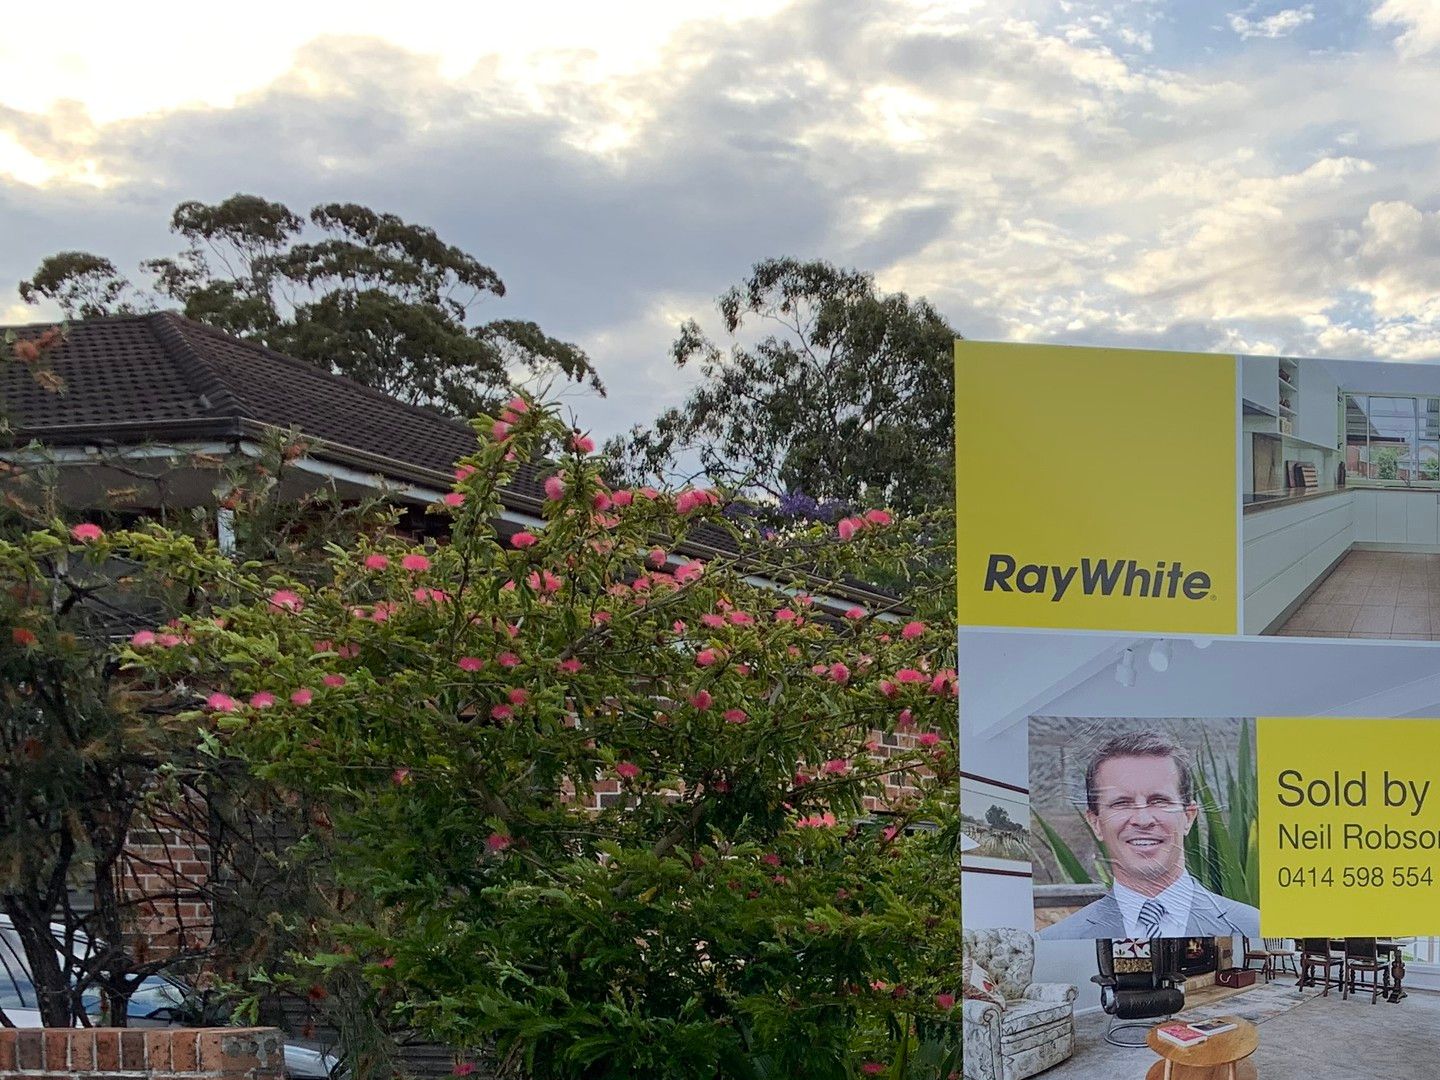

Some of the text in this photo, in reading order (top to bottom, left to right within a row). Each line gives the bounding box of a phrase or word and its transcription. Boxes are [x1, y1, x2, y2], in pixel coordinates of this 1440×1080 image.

[1277, 769, 1431, 817] Sold by
[1278, 823, 1332, 850] Neil
[1277, 866, 1434, 888] 0414 598 554
